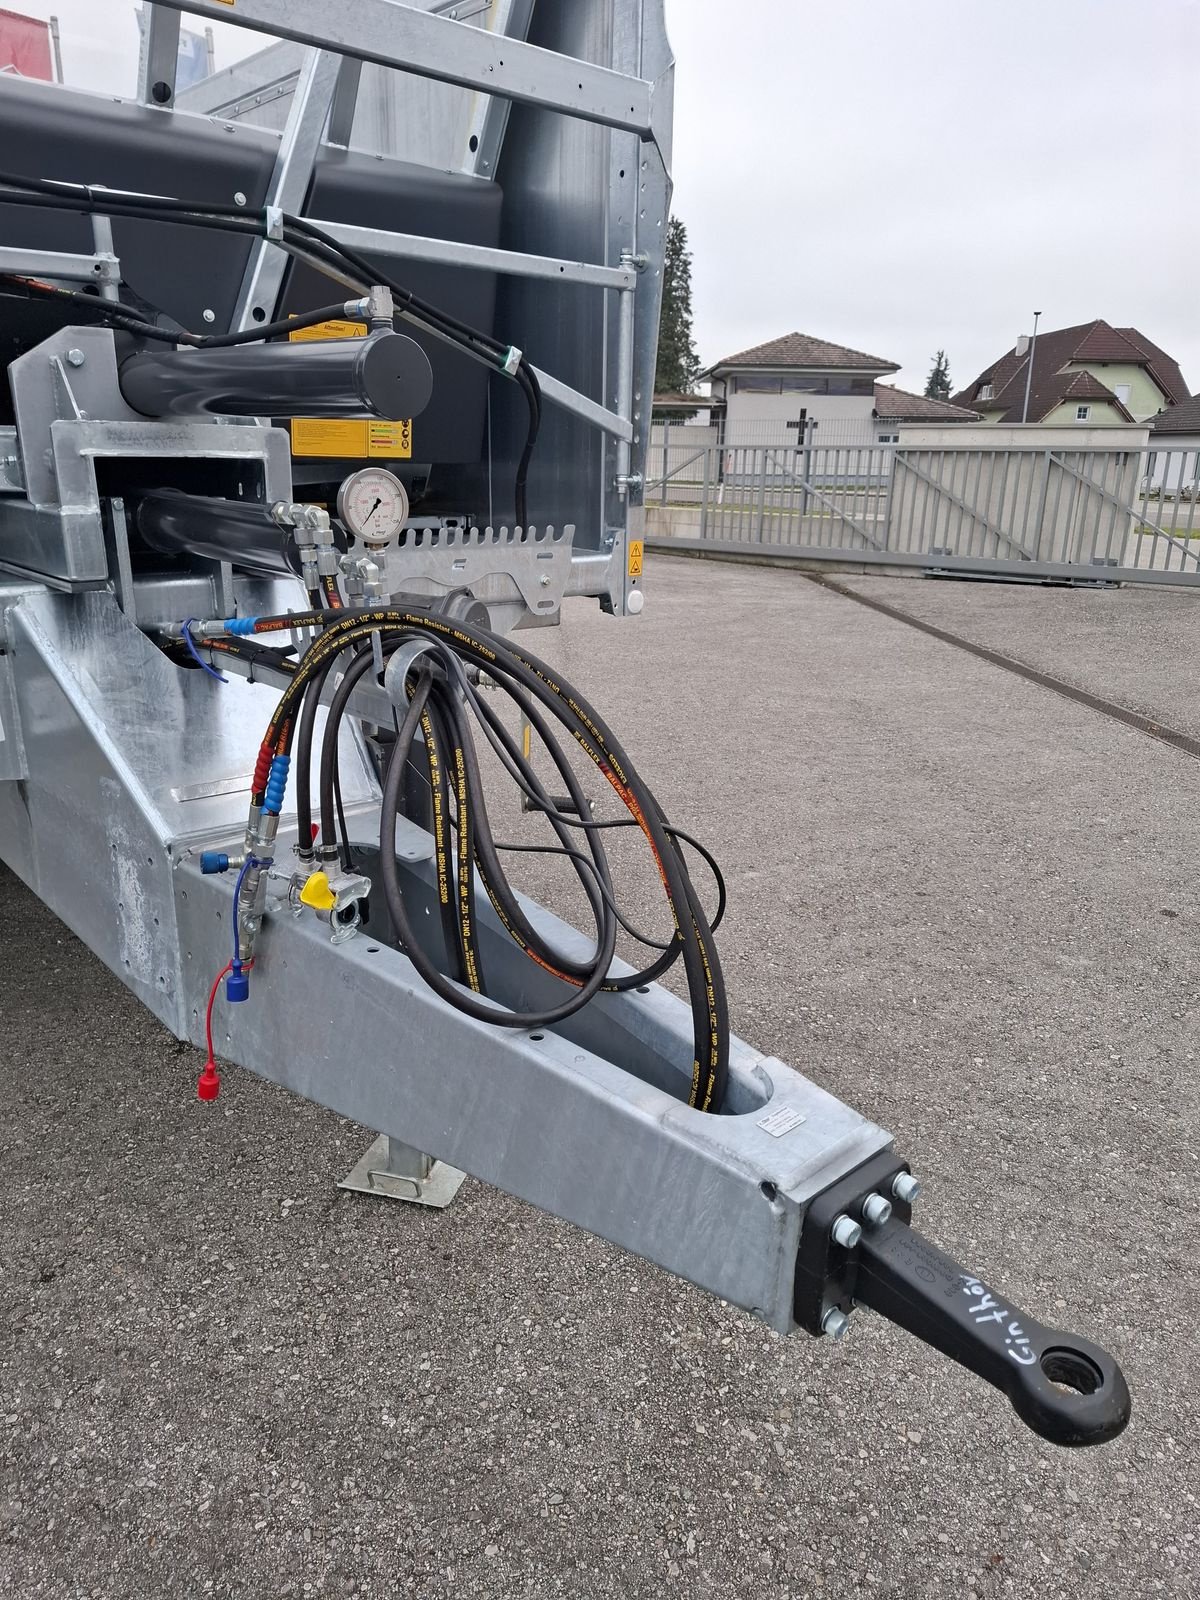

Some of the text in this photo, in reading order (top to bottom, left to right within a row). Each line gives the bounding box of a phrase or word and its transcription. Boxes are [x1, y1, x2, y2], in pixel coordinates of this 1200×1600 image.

[292, 617, 316, 626] BALFLEX
[341, 618, 357, 630] DN12
[375, 612, 384, 620] WP
[406, 614, 424, 624] Flame
[424, 618, 451, 634] Resistant
[454, 630, 472, 646] MSHA
[472, 640, 496, 661] IC-252/00
[422, 716, 432, 734] DN12
[430, 754, 438, 766] WP
[456, 748, 465, 778] IC-252/00
[580, 739, 600, 763] BALFLEX
[606, 772, 627, 799] BALPAC
[608, 754, 627, 784] EXCEEDS
[458, 778, 466, 800] MSHA
[434, 793, 442, 814] Flame
[460, 804, 468, 836] Resistant
[436, 815, 444, 848] Resistant
[460, 839, 468, 859] Flame
[438, 852, 446, 872] MSHA
[440, 874, 448, 904] IC-252/00
[461, 884, 468, 897] WP
[707, 986, 715, 1006] DN12
[712, 1032, 718, 1046] WP
[706, 1074, 715, 1094] Flame
